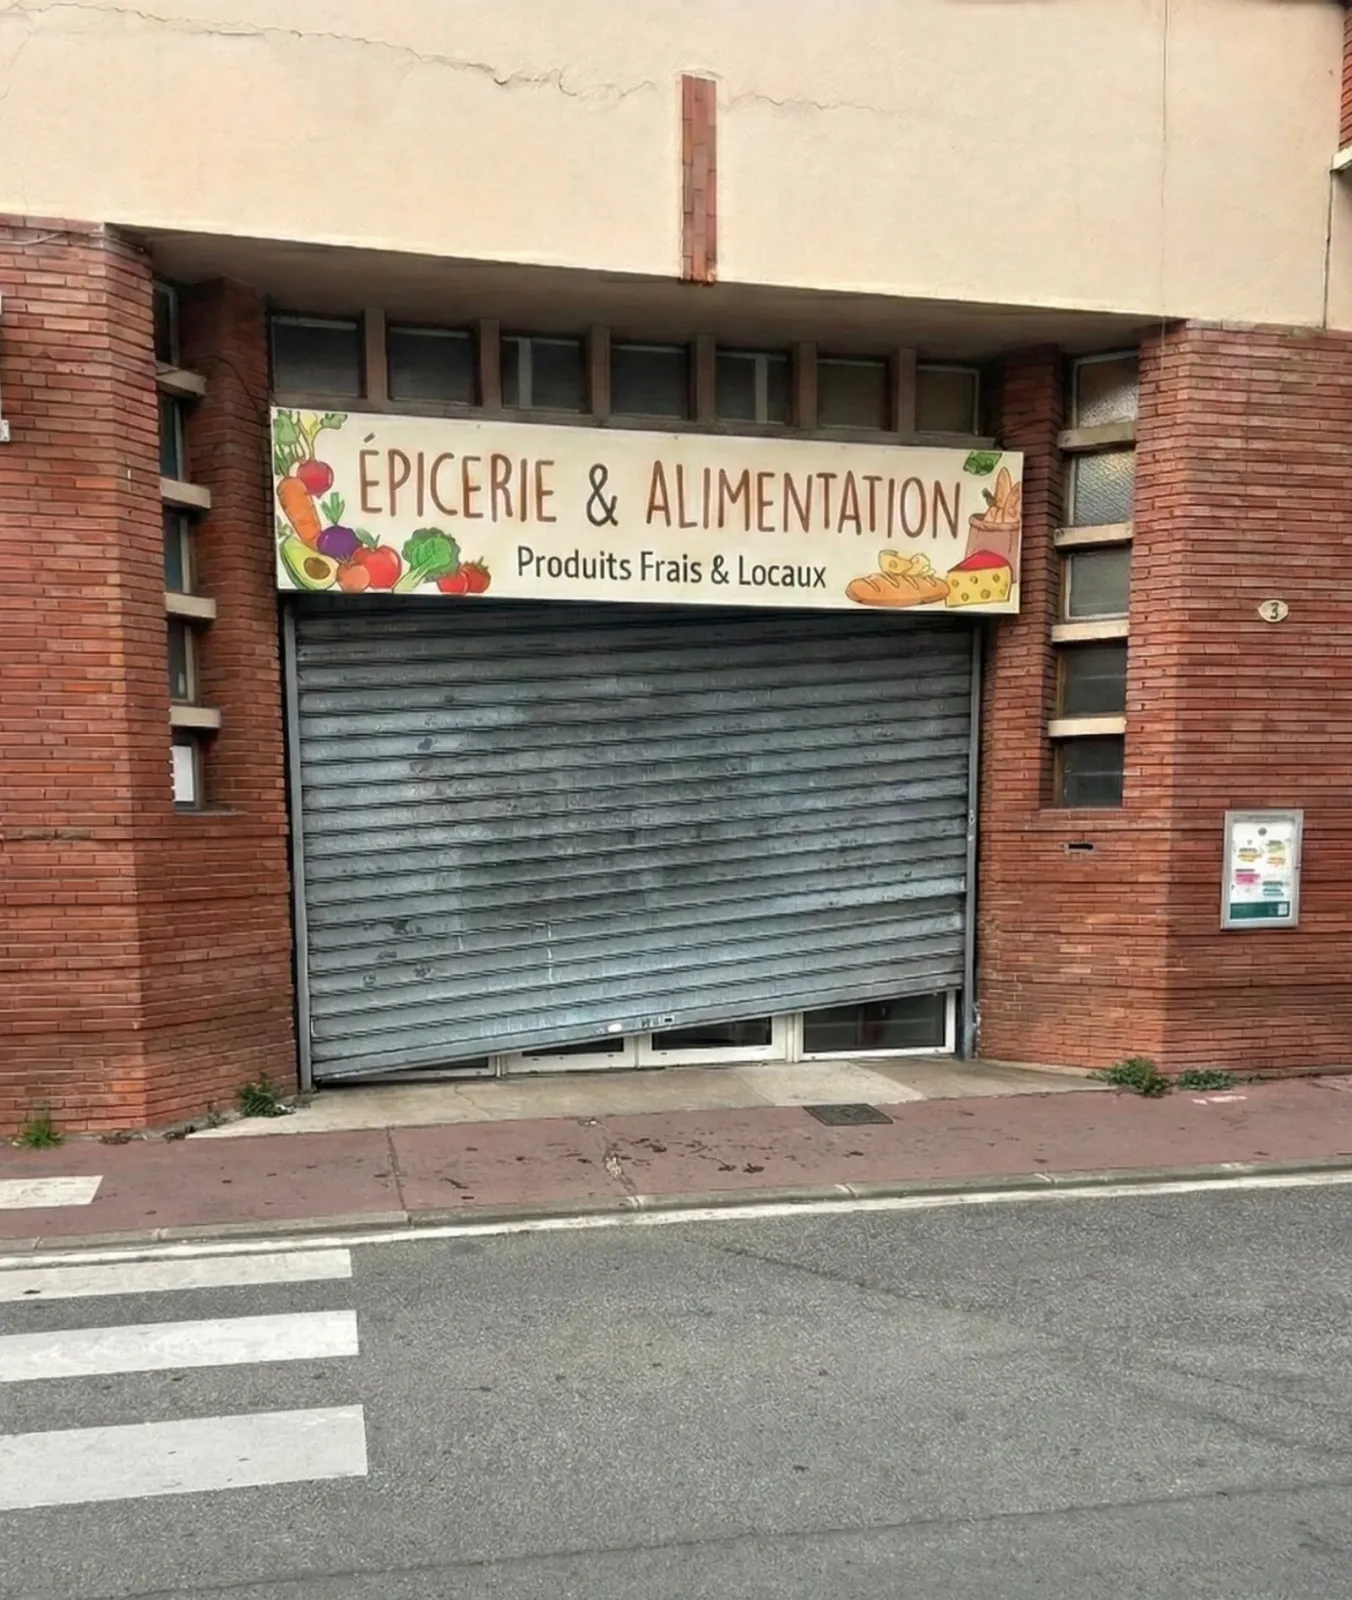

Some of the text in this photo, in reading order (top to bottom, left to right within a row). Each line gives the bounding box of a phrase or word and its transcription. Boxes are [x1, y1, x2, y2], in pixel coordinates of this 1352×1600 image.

[359, 432, 960, 539] ÉPICERIE & ALIMENTATION
[517, 545, 826, 588] Produits Frais & Locaux
[1270, 601, 1279, 619] 3
